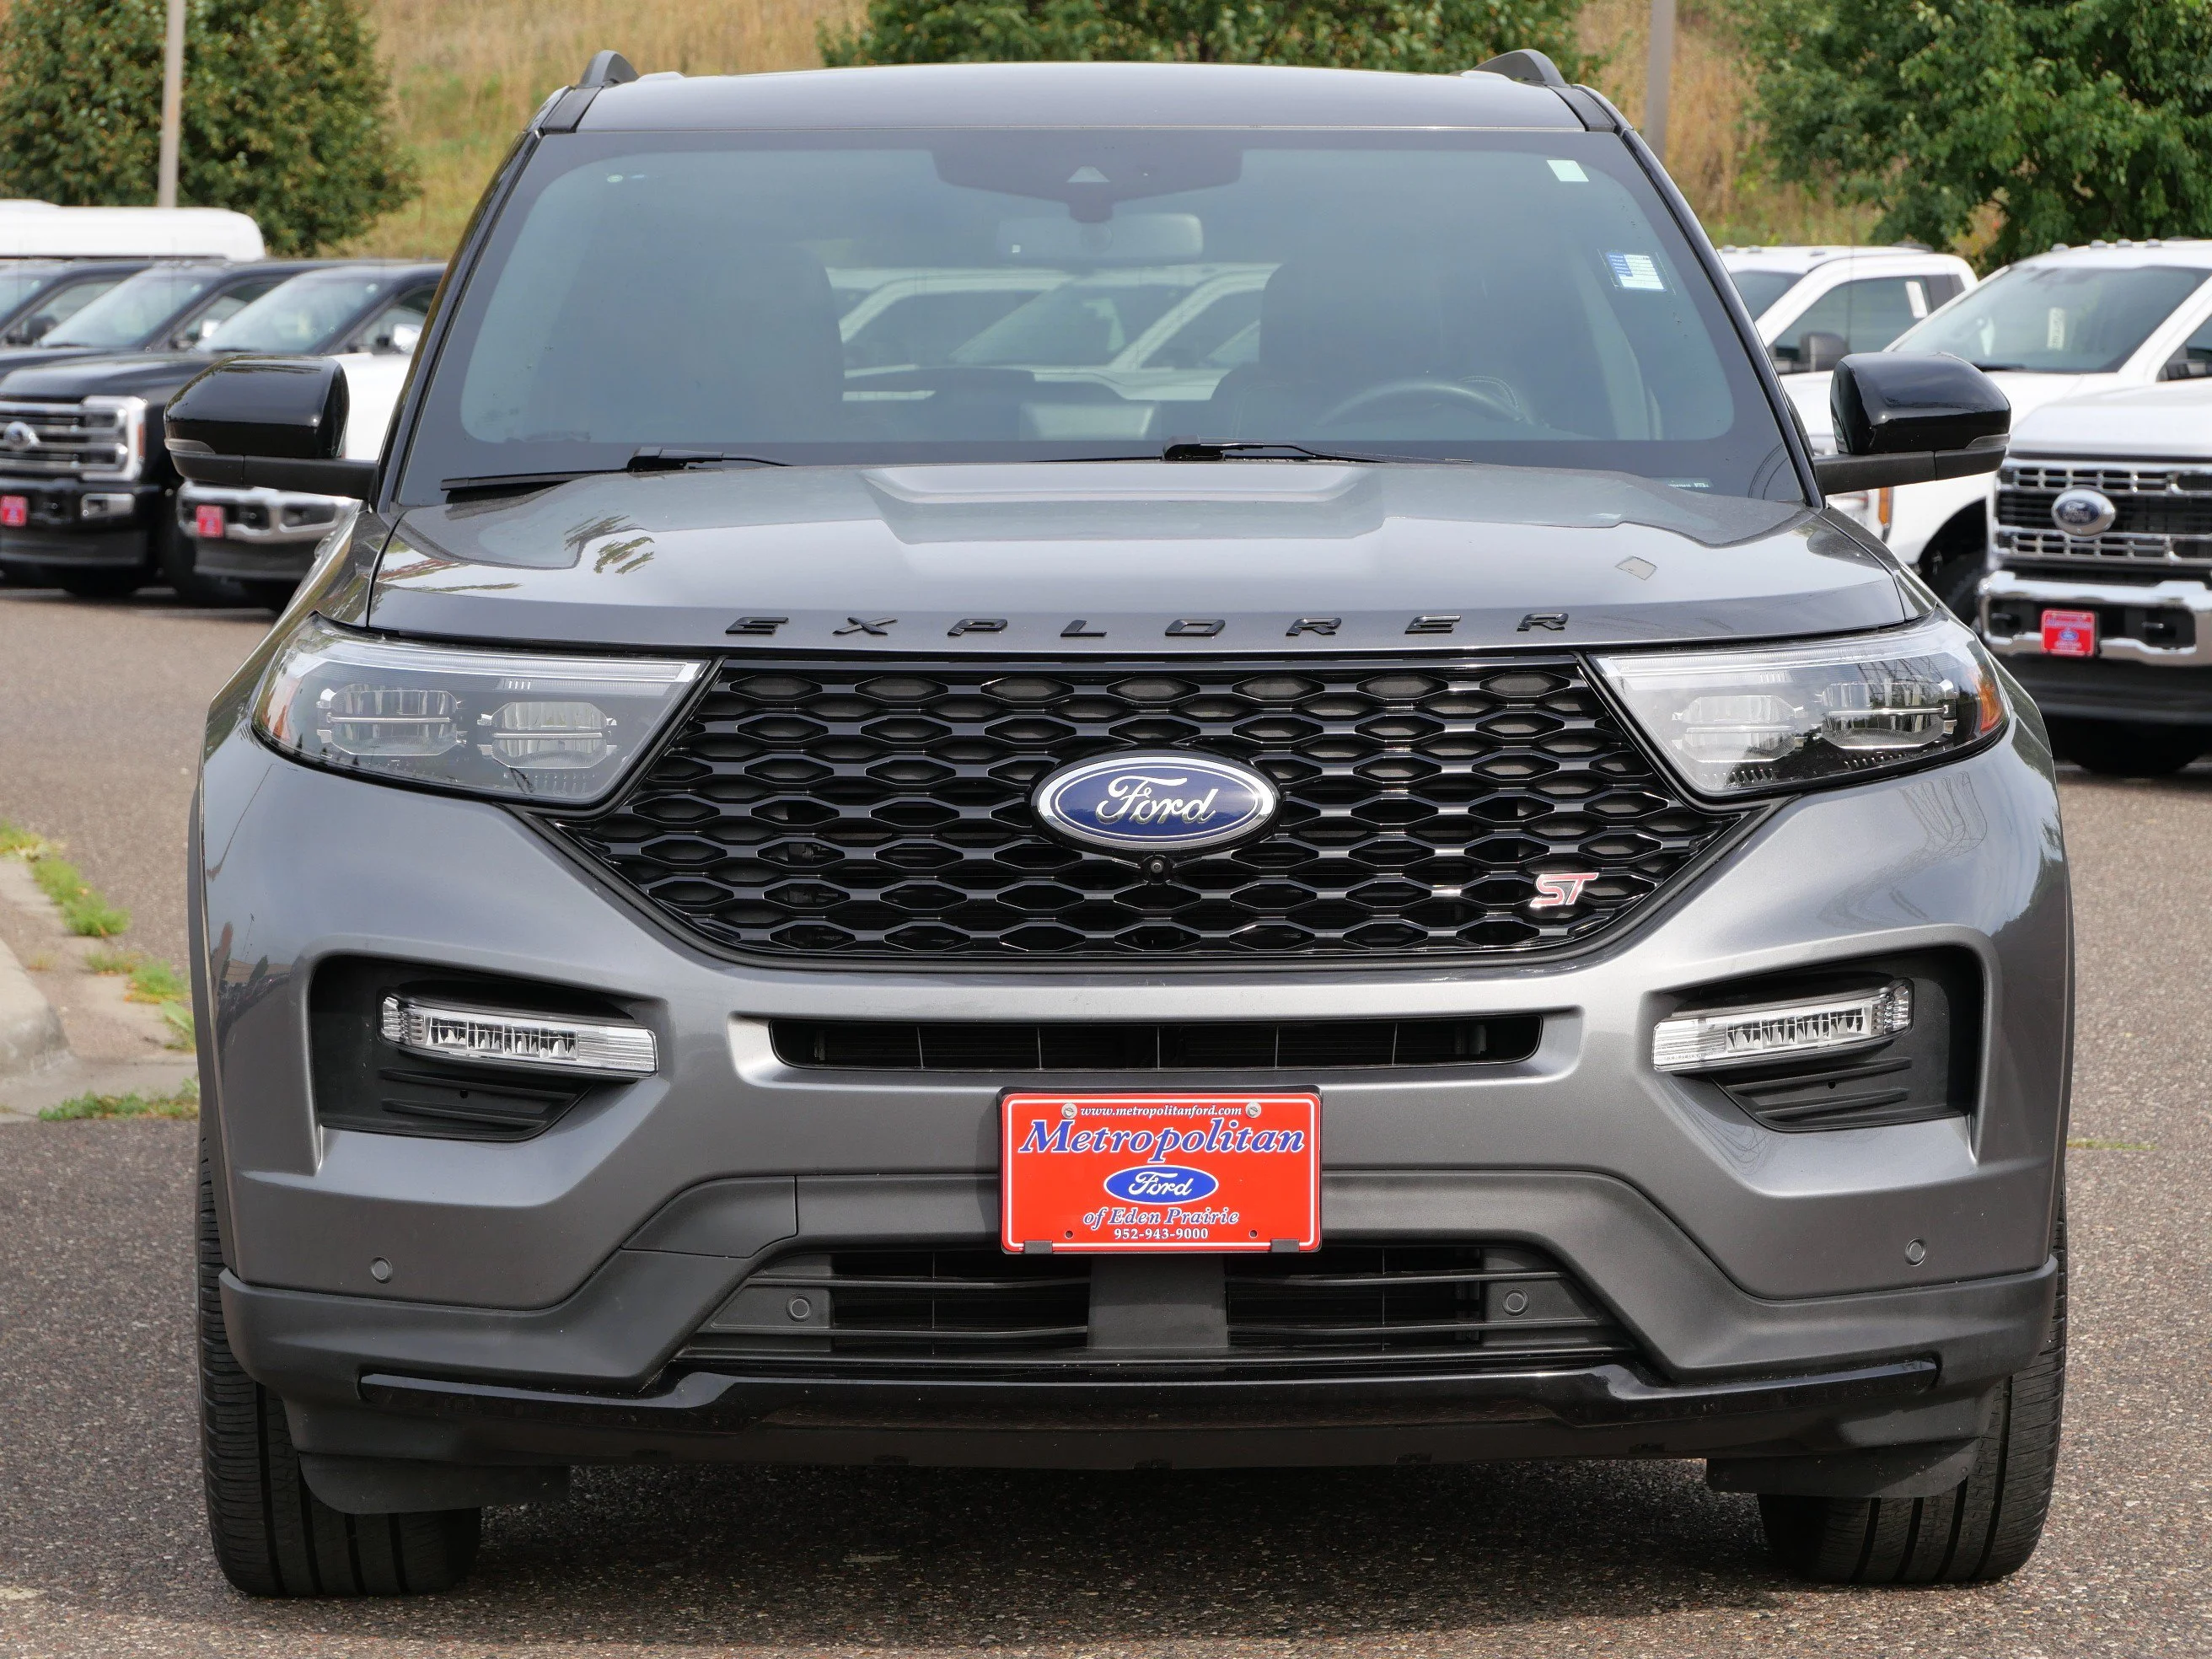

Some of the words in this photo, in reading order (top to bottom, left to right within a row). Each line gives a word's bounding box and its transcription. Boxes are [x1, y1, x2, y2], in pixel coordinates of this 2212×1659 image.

[725, 613, 1570, 637] EXPLORER
[1096, 775, 1219, 824] Ford
[1530, 872, 1599, 908] ST
[1080, 1104, 1243, 1118] www.metropolitanford.com
[1018, 1118, 1305, 1163] Metropolitan
[1128, 1171, 1194, 1196] Ford
[1083, 1207, 1107, 1230] of
[1109, 1207, 1161, 1225] Eden
[1166, 1207, 1239, 1225] Prairie
[1114, 1227, 1209, 1240] 952-943-9000
